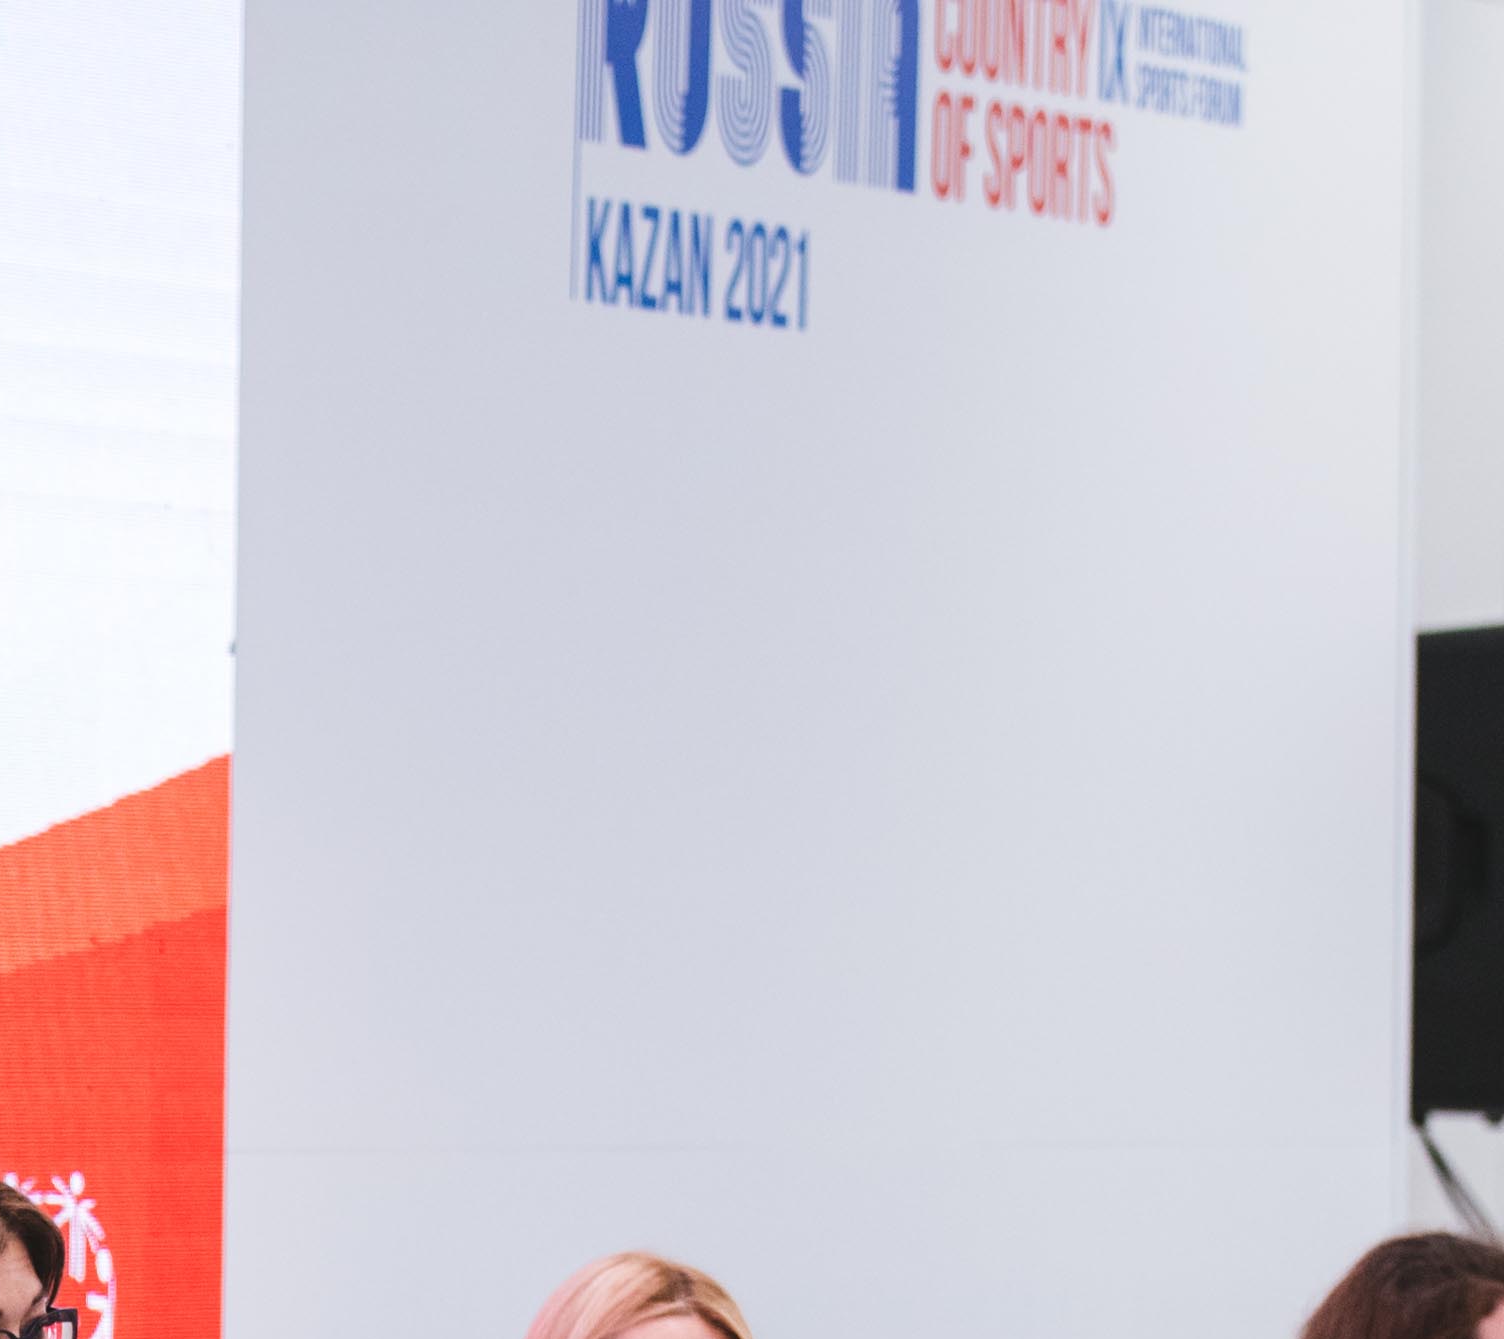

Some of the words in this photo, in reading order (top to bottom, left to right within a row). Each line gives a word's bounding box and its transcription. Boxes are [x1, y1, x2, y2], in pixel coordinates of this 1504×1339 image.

[578, 0, 918, 194] RUSSIA
[933, 0, 1092, 97] COUNTRY
[930, 90, 976, 201] OF
[984, 100, 1115, 228] SPORTS
[586, 196, 712, 319] KAZAN
[726, 217, 810, 332] 2021
